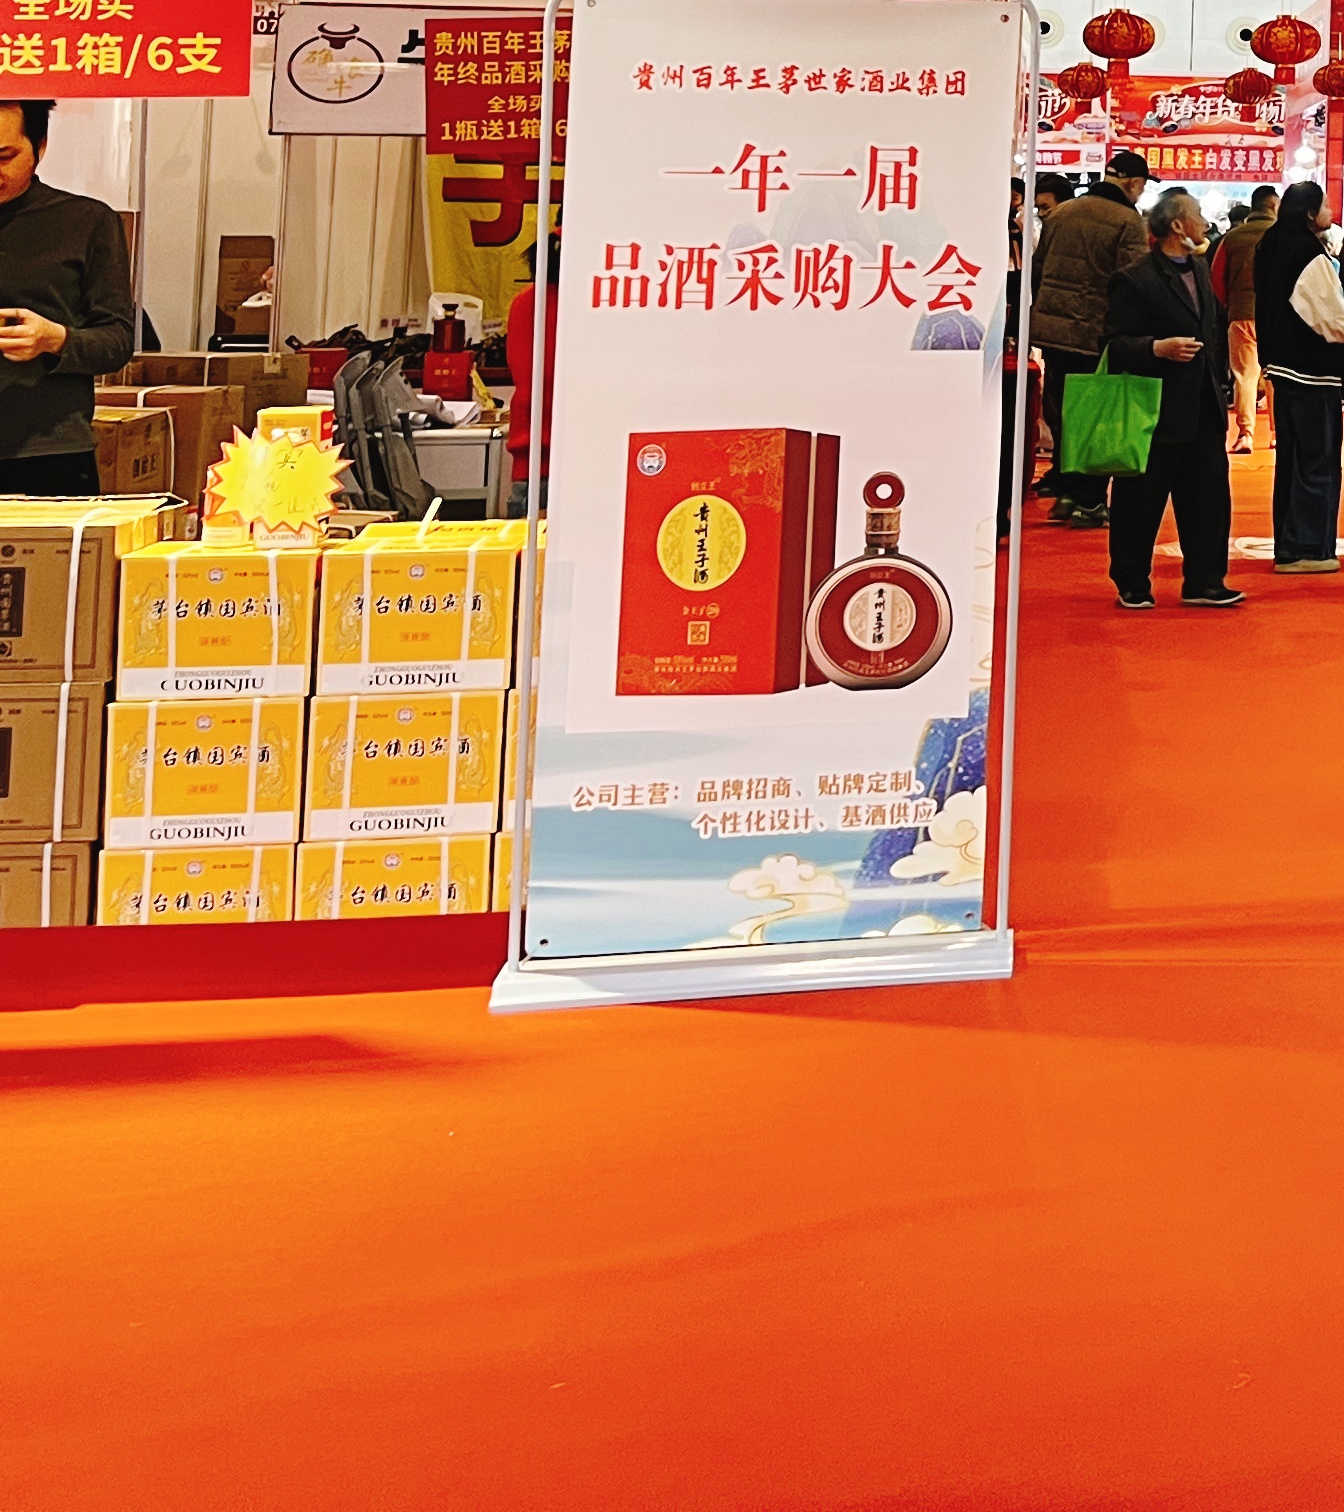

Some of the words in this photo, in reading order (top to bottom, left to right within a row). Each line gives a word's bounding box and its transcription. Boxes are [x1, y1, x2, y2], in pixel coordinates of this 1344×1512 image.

[0, 32, 222, 79] 送1箱/6支
[441, 118, 567, 142] 1瓶送1箱6
[1153, 93, 1285, 125] 新春年货物
[662, 142, 921, 214] 一年一届
[591, 241, 984, 313] 品酒采购大会
